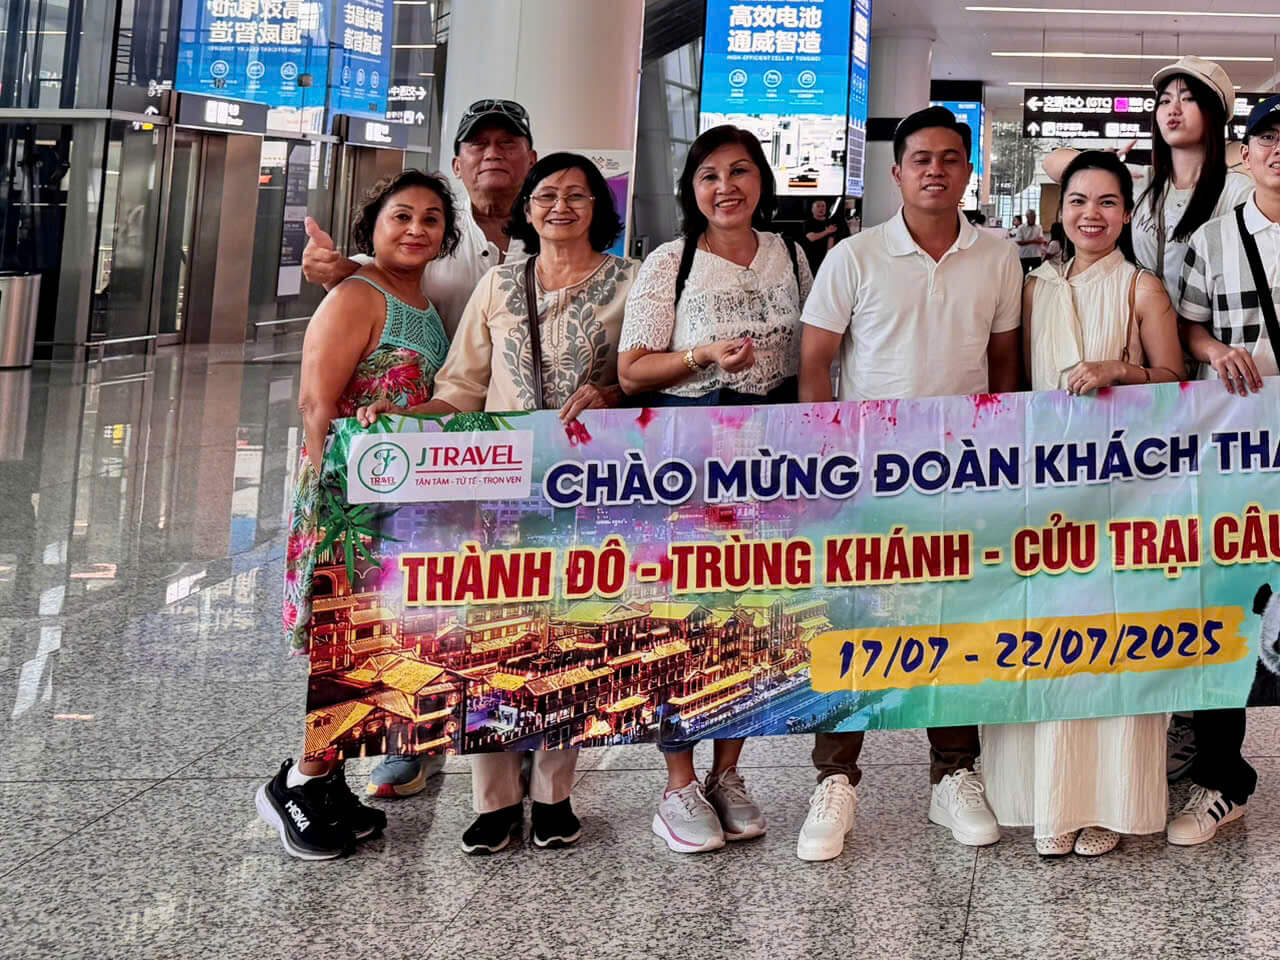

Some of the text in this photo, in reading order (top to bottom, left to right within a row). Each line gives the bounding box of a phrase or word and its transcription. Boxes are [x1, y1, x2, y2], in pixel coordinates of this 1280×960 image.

[729, 4, 822, 29] 高效电池
[728, 30, 821, 54] 通威智造
[415, 445, 523, 467] JTRAVEL
[545, 449, 695, 504] CHÀO
[707, 448, 860, 499] MỪNG
[874, 439, 1020, 493] ĐOÀN
[1034, 430, 1200, 486] KHÁCH
[402, 545, 552, 603] THÀNH
[566, 538, 626, 597] ĐÔ
[671, 535, 812, 591] TRÙNG
[825, 527, 970, 583] KHÁNH
[1013, 513, 1097, 573] CỬU
[1108, 518, 1199, 574] TRẠI
[839, 636, 949, 680] 17/07
[995, 620, 1223, 671] 22/07/2025
[285, 800, 311, 832] HOKA
